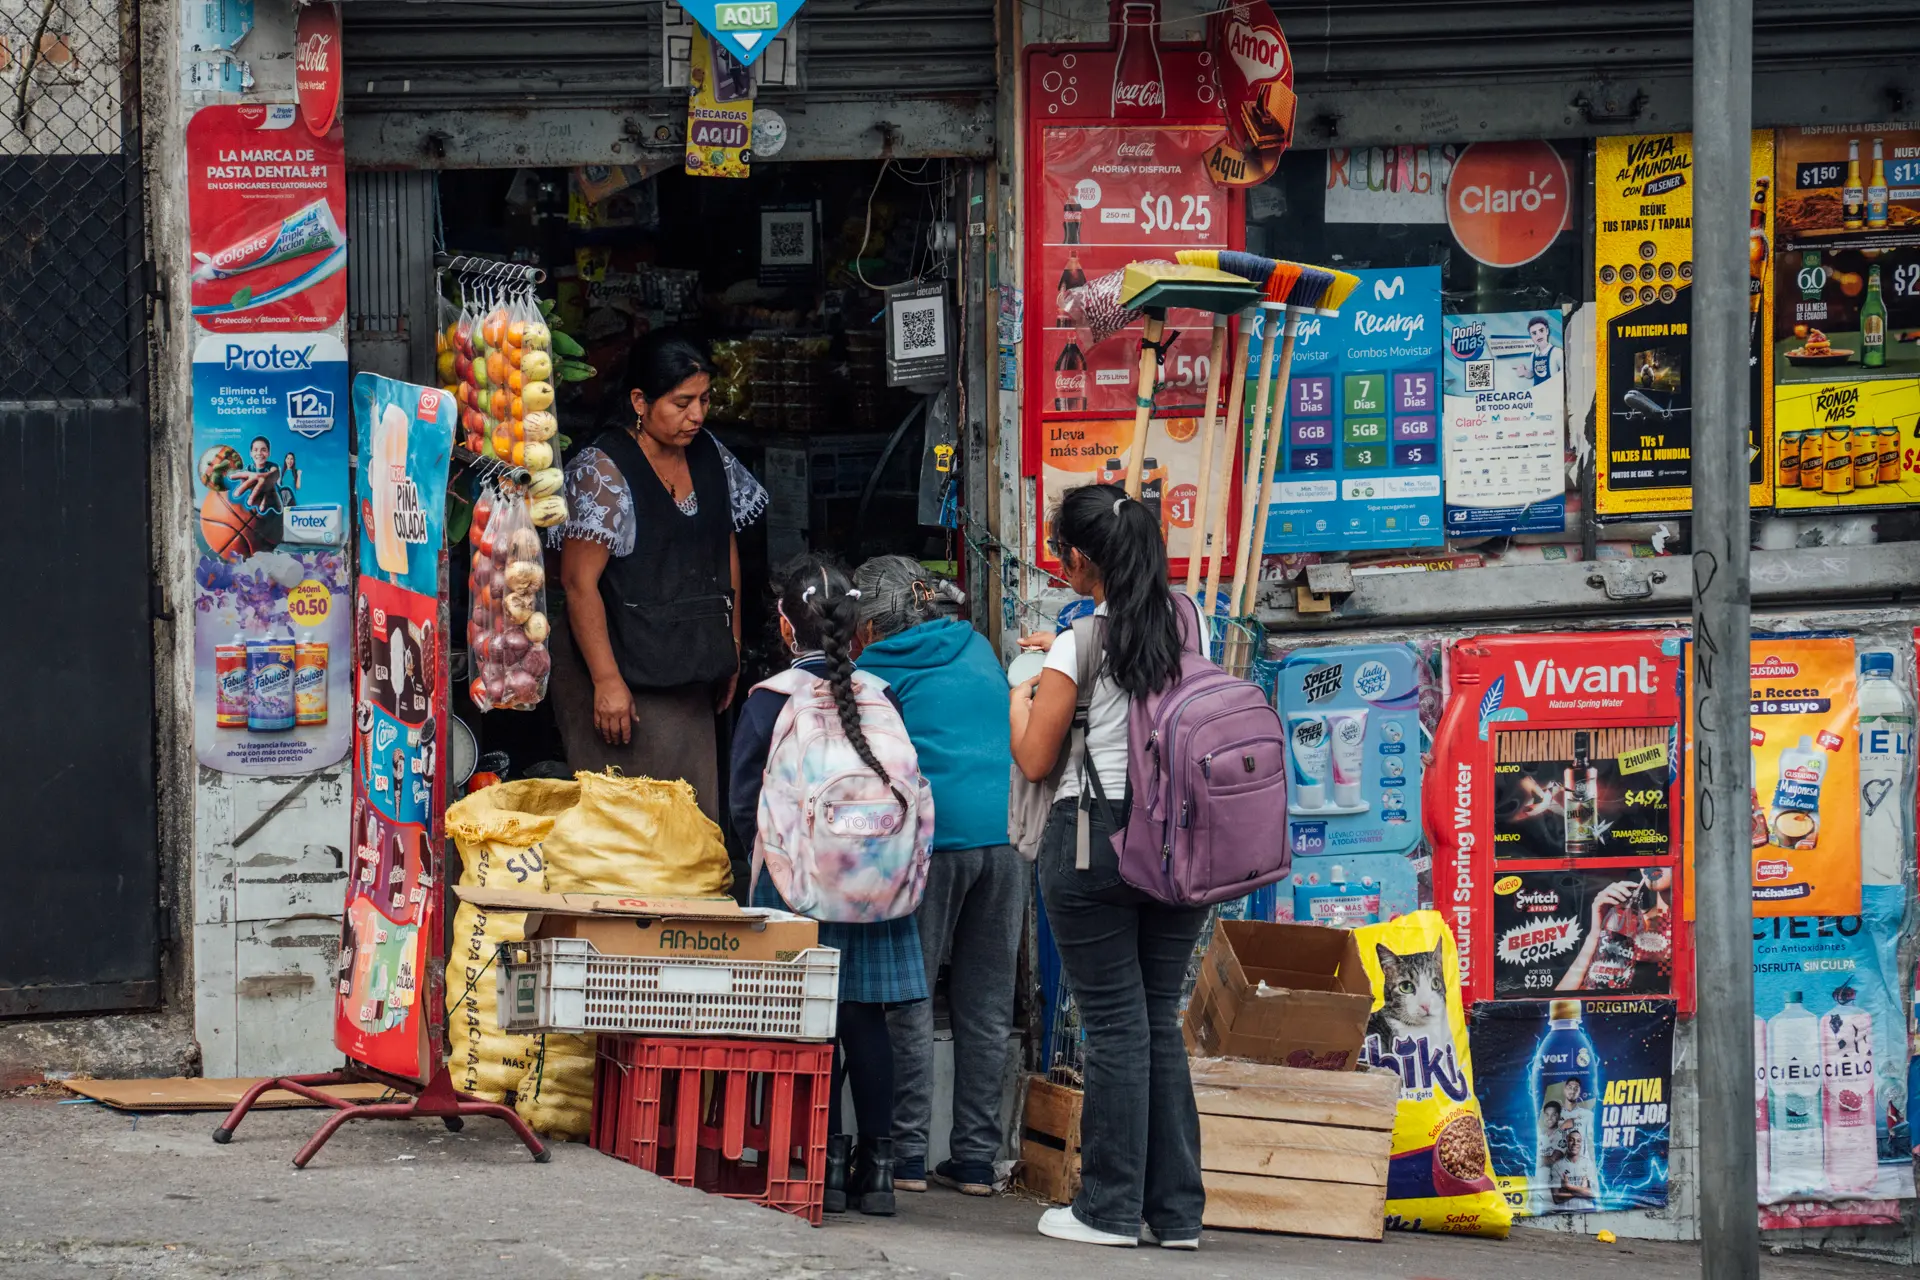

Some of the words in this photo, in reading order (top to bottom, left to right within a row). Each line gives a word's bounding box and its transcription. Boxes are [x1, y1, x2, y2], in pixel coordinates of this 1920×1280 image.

[723, 5, 772, 26] AQUÍ
[1230, 26, 1279, 68] Amor
[1115, 80, 1162, 106] Coca-Cola
[695, 109, 748, 120] RECARGAS
[696, 125, 743, 144] AQUÍ
[219, 150, 239, 162] LA
[241, 150, 293, 162] MARCA
[296, 149, 315, 162] DE
[1117, 142, 1156, 157] Coca-Cola
[1627, 136, 1677, 167] VIAJA
[207, 166, 252, 179] PASTA
[255, 166, 310, 178] DENTAL
[311, 166, 328, 177] #1
[1091, 165, 1130, 174] AHORRA
[1130, 165, 1138, 174] Y
[1138, 165, 1182, 174] DISFRUTA
[1615, 168, 1633, 182] AL
[1631, 154, 1693, 184] MUNDIAL
[271, 182, 328, 190] ECUATORIANOS
[1622, 185, 1643, 198] CON
[1647, 176, 1682, 195] PILSENER
[1460, 180, 1546, 214] Claro
[1140, 191, 1211, 235] $0.25
[1639, 202, 1667, 216] REÚNE
[1602, 221, 1618, 233] TUS
[1621, 219, 1649, 232] TAPAS
[215, 238, 268, 266] Colgate
[1797, 267, 1827, 289] 60
[1796, 304, 1804, 313] EN
[1804, 303, 1811, 312] LA
[1811, 302, 1828, 311] MESA
[1796, 312, 1803, 321] DE
[1803, 311, 1828, 321] ECUADOR
[1354, 310, 1425, 341] Recarga
[1623, 324, 1669, 338] PARTICIPA
[1669, 323, 1688, 336] POR
[1864, 334, 1883, 343] CLUB
[225, 344, 317, 371] Protex
[1347, 347, 1388, 359] Combos
[1390, 346, 1432, 357] Movistar
[1111, 373, 1129, 381] Litros
[219, 387, 256, 395] Elimina
[258, 386, 268, 395] el
[1300, 383, 1323, 401] 15
[1359, 380, 1371, 398] 7
[1403, 378, 1427, 396] 15
[246, 396, 260, 405] de
[261, 396, 277, 405] las
[292, 394, 328, 416] 12h
[1353, 399, 1376, 410] Días
[1403, 397, 1426, 407] Días
[1475, 391, 1533, 405] ¡RECARGA
[1816, 387, 1861, 412] RONDA
[1300, 402, 1322, 412] Días
[1487, 403, 1511, 411] TODO
[1512, 401, 1534, 409] AQUÍ!
[1824, 404, 1856, 422] MÁS
[1050, 428, 1085, 442] Lleva
[1298, 426, 1325, 439] 6GB
[1352, 424, 1378, 437] 5GB
[1402, 421, 1428, 434] 6GB
[1639, 435, 1656, 448] TVs
[1050, 445, 1078, 457] más
[1081, 444, 1119, 457] sabor
[1358, 450, 1372, 464] $3
[1408, 448, 1422, 462] $5
[1611, 450, 1640, 463] VIAJES
[1640, 449, 1652, 461] AL
[1653, 447, 1690, 461] MUNDIAL
[1305, 453, 1319, 466] $5
[396, 480, 419, 512] PIÑA
[1172, 499, 1193, 521] $1
[291, 514, 328, 528] Protex
[394, 510, 428, 541] COLADA
[289, 599, 328, 616] $0.50
[255, 668, 290, 689] Fabuloso
[1302, 663, 1342, 692] SPEED
[1514, 657, 1657, 698] Vivant
[1750, 667, 1795, 677] GUSTADINA
[1355, 672, 1386, 690] Speed
[1306, 676, 1343, 704] STICK
[1765, 688, 1819, 698] Receta
[1548, 700, 1576, 709] Natural
[1576, 699, 1600, 709] Spring
[1600, 698, 1623, 708] Water
[1762, 702, 1777, 712] lo
[1780, 701, 1819, 714] suyo
[1296, 722, 1323, 738] SPEED
[1299, 730, 1323, 746] STICK
[246, 742, 277, 750] fragancia
[277, 754, 303, 763] precio
[1494, 766, 1520, 774] NUEVO
[1785, 771, 1819, 780] GUSTADINA
[1454, 762, 1472, 829] Water
[1779, 780, 1818, 798] Mayonesa
[1624, 789, 1664, 806] $4,99
[1355, 828, 1384, 837] CONTIGO
[1494, 834, 1521, 842] NUEVO
[1612, 829, 1655, 840] TAMARINDO
[1628, 833, 1669, 844] CARIBEÑO
[1296, 834, 1322, 852] $1.00
[1337, 838, 1357, 846] TODAS
[1357, 836, 1383, 844] PARTES
[1452, 834, 1475, 902] Spring
[1497, 879, 1519, 893] NUEVO
[1515, 890, 1559, 909] Switch
[467, 914, 487, 962] PAPA
[1508, 923, 1570, 951] BERRY
[1453, 907, 1471, 986] Natural
[1519, 941, 1558, 960] COOL
[1757, 945, 1777, 954] Con
[1780, 944, 1846, 953] Antioxidantes
[1803, 961, 1819, 972] SIN
[1820, 960, 1856, 971] CULPA
[1524, 974, 1553, 989] $2,99
[1586, 1001, 1656, 1015] ORIGINAL
[1542, 1053, 1569, 1065] VOLT
[1359, 1034, 1468, 1104] hiki
[1770, 1064, 1821, 1080] CIELO
[1824, 1060, 1872, 1078] CIELO
[1416, 1091, 1433, 1103] gato
[1602, 1078, 1662, 1106] ACTIVA
[1601, 1106, 1619, 1127] LO
[1619, 1103, 1668, 1126] MEJOR
[1428, 1119, 1446, 1140] Sabor
[1601, 1127, 1620, 1149] DE
[1620, 1126, 1636, 1147] TI
[1444, 1214, 1480, 1225] Sabor
